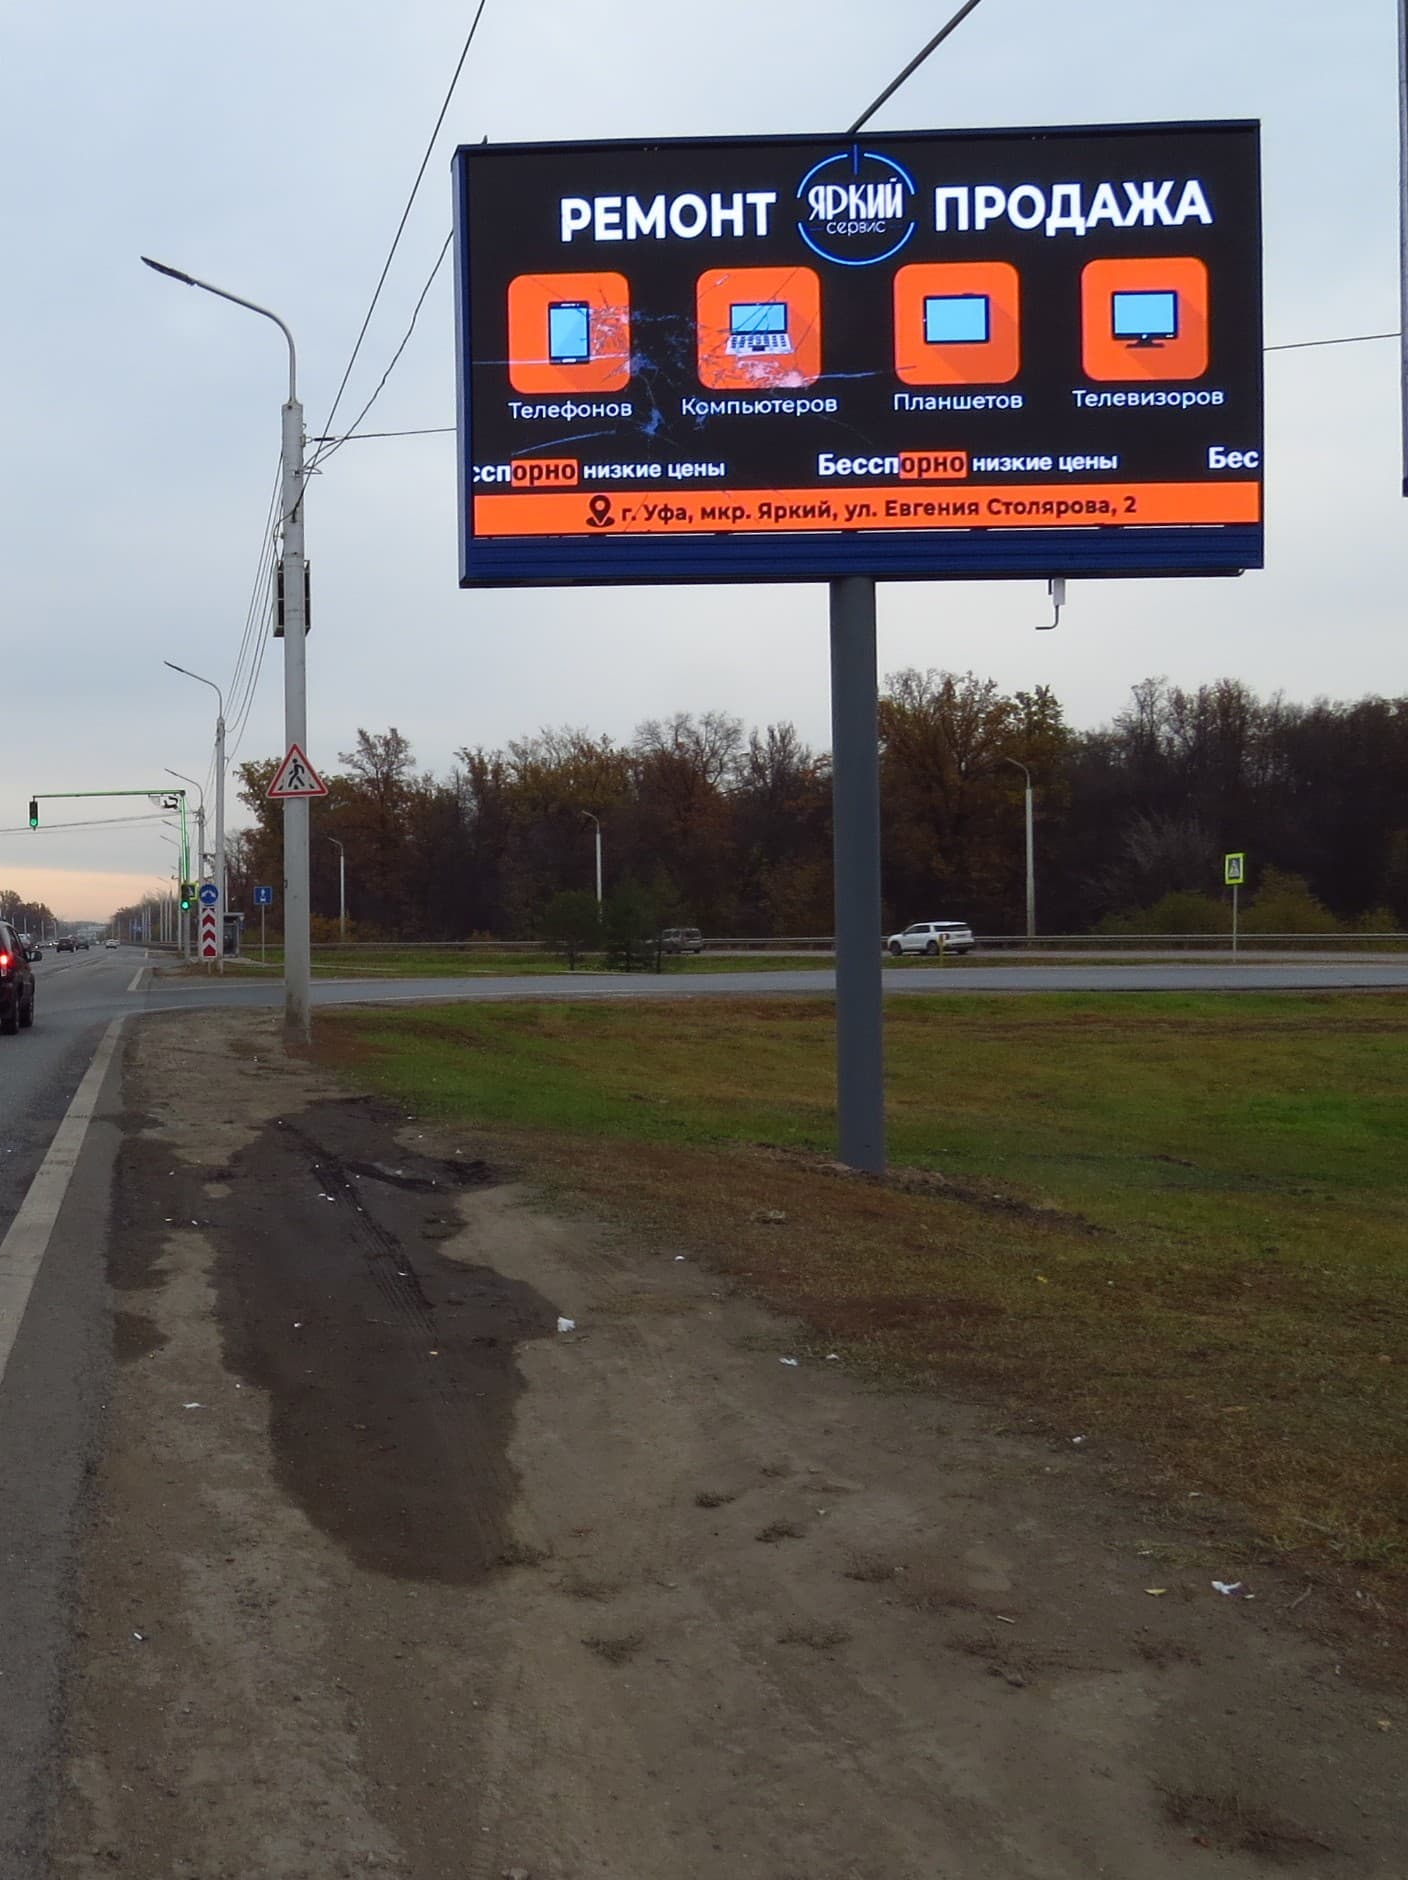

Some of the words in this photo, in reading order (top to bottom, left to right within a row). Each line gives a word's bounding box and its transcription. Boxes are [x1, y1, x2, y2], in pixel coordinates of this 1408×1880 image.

[807, 177, 904, 221] ЯРКИЙ
[935, 179, 1213, 237] ПРОДАЖА
[560, 192, 777, 242] РЕМОНТ
[825, 220, 887, 236] сервис
[681, 398, 839, 418] Компьютеров
[893, 393, 1023, 411] Планшетов
[1072, 388, 1225, 409] Телевизоров
[508, 401, 633, 421] Телефонов
[818, 453, 965, 478] Бесспорно
[972, 455, 1052, 472] низкие
[1058, 453, 1118, 473] цены
[1208, 446, 1259, 469] Бес
[583, 463, 662, 479] низкие
[667, 461, 725, 480] цены
[621, 507, 637, 521] г.
[643, 503, 693, 525] Уфа,
[700, 505, 751, 524] мкр.
[758, 500, 838, 523] Яркий,
[844, 502, 878, 522] ул.
[884, 498, 980, 518] Евгения
[986, 496, 1118, 520] Столярова,
[1123, 496, 1137, 513] 2
